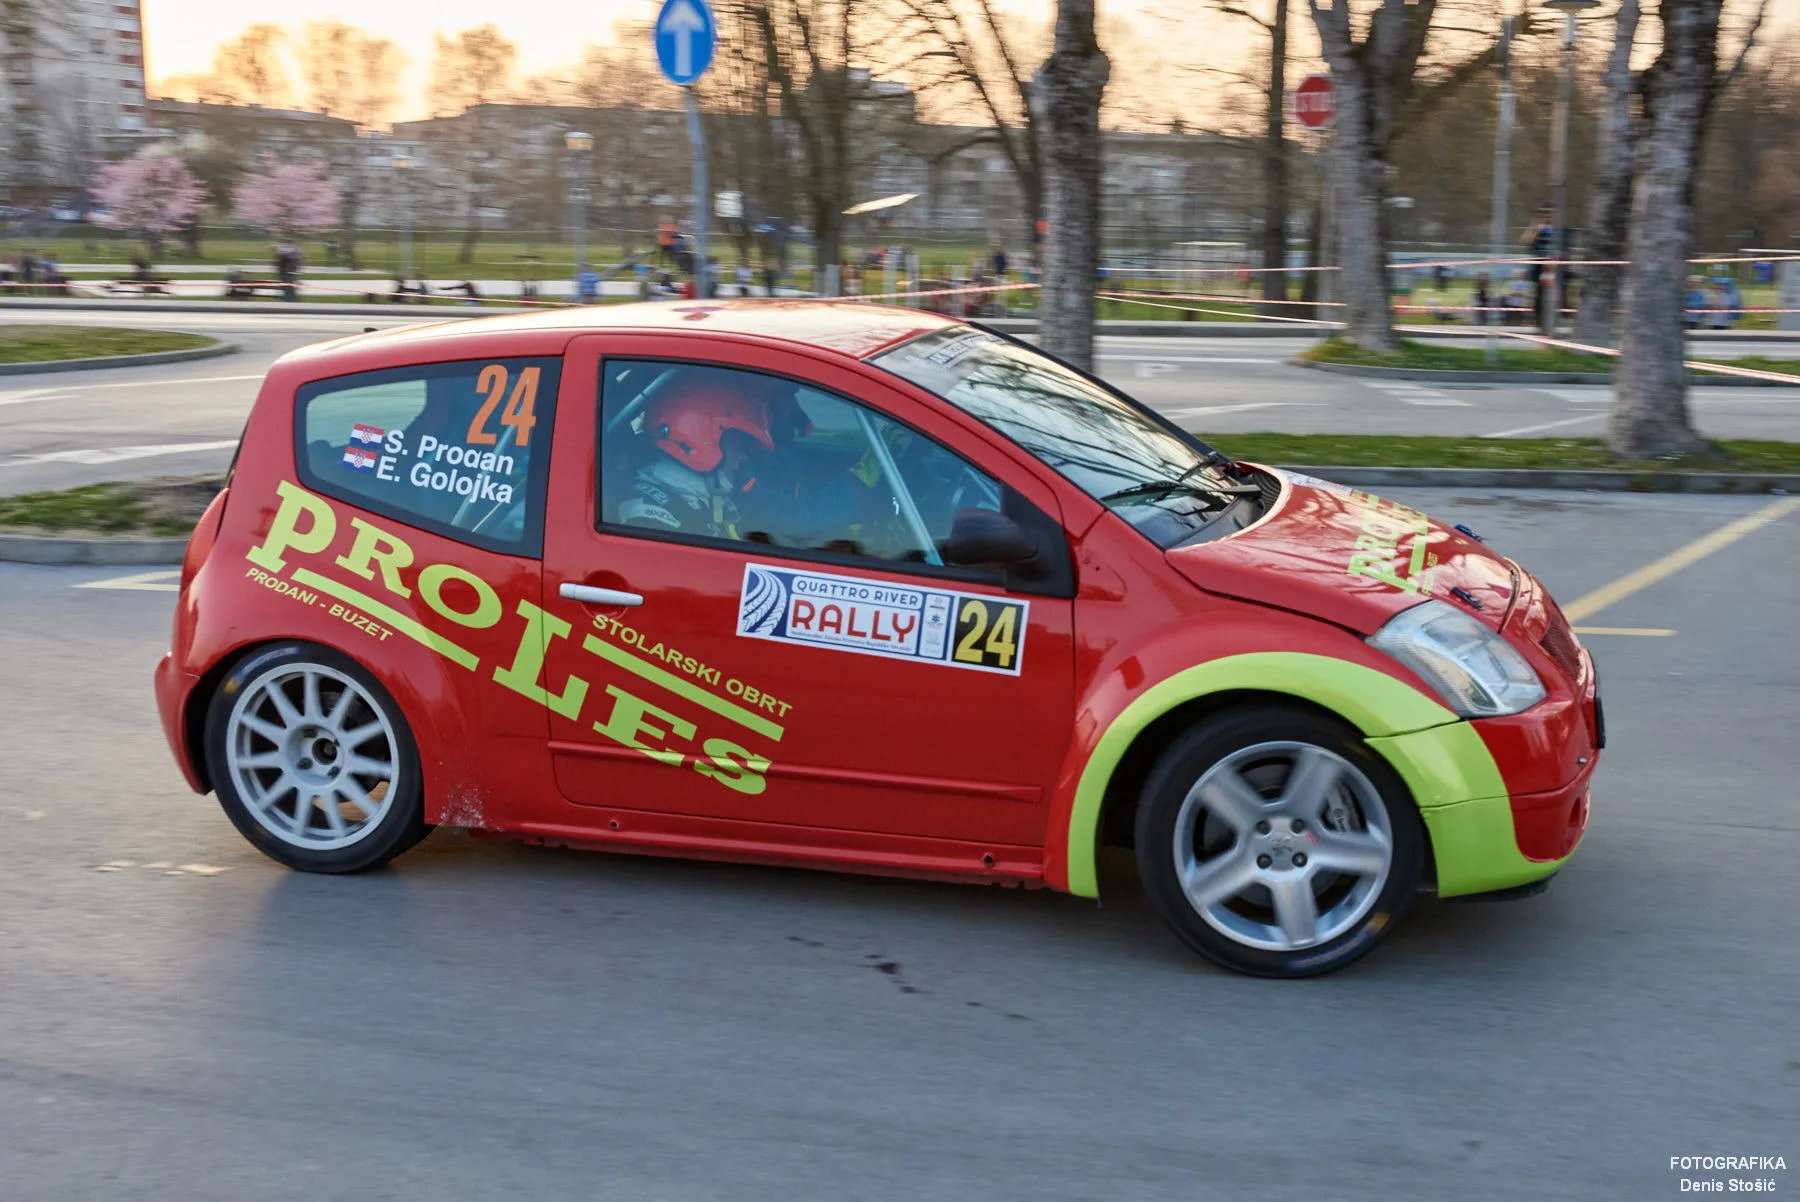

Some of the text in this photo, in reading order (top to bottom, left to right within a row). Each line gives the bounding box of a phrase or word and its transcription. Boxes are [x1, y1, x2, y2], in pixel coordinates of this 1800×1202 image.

[466, 364, 541, 446] 24
[384, 429, 408, 456] S.
[376, 455, 513, 504] E. Golojka
[245, 567, 318, 606] PRODANI
[328, 603, 393, 641] BUZET
[791, 599, 916, 644] RALLY
[796, 580, 918, 606] QUATTRO RIVER
[954, 600, 1017, 667] 24
[592, 613, 793, 718] STOLARSKI OBRT
